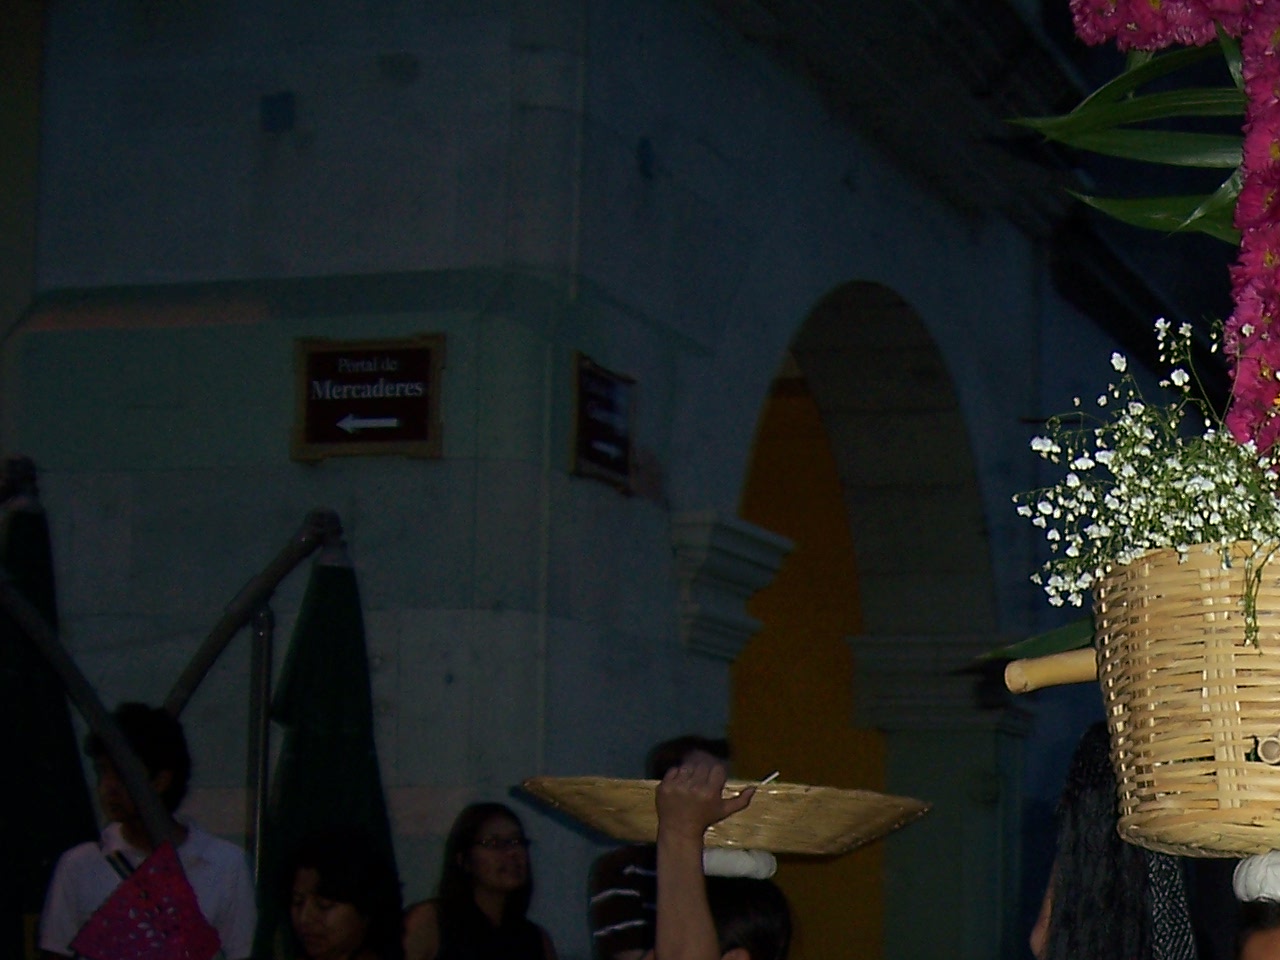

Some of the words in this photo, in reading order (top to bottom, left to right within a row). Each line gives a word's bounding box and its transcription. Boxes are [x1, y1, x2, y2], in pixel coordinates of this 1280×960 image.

[338, 357, 377, 373] Portal
[381, 356, 399, 371] de
[312, 378, 425, 400] Mercaderes
